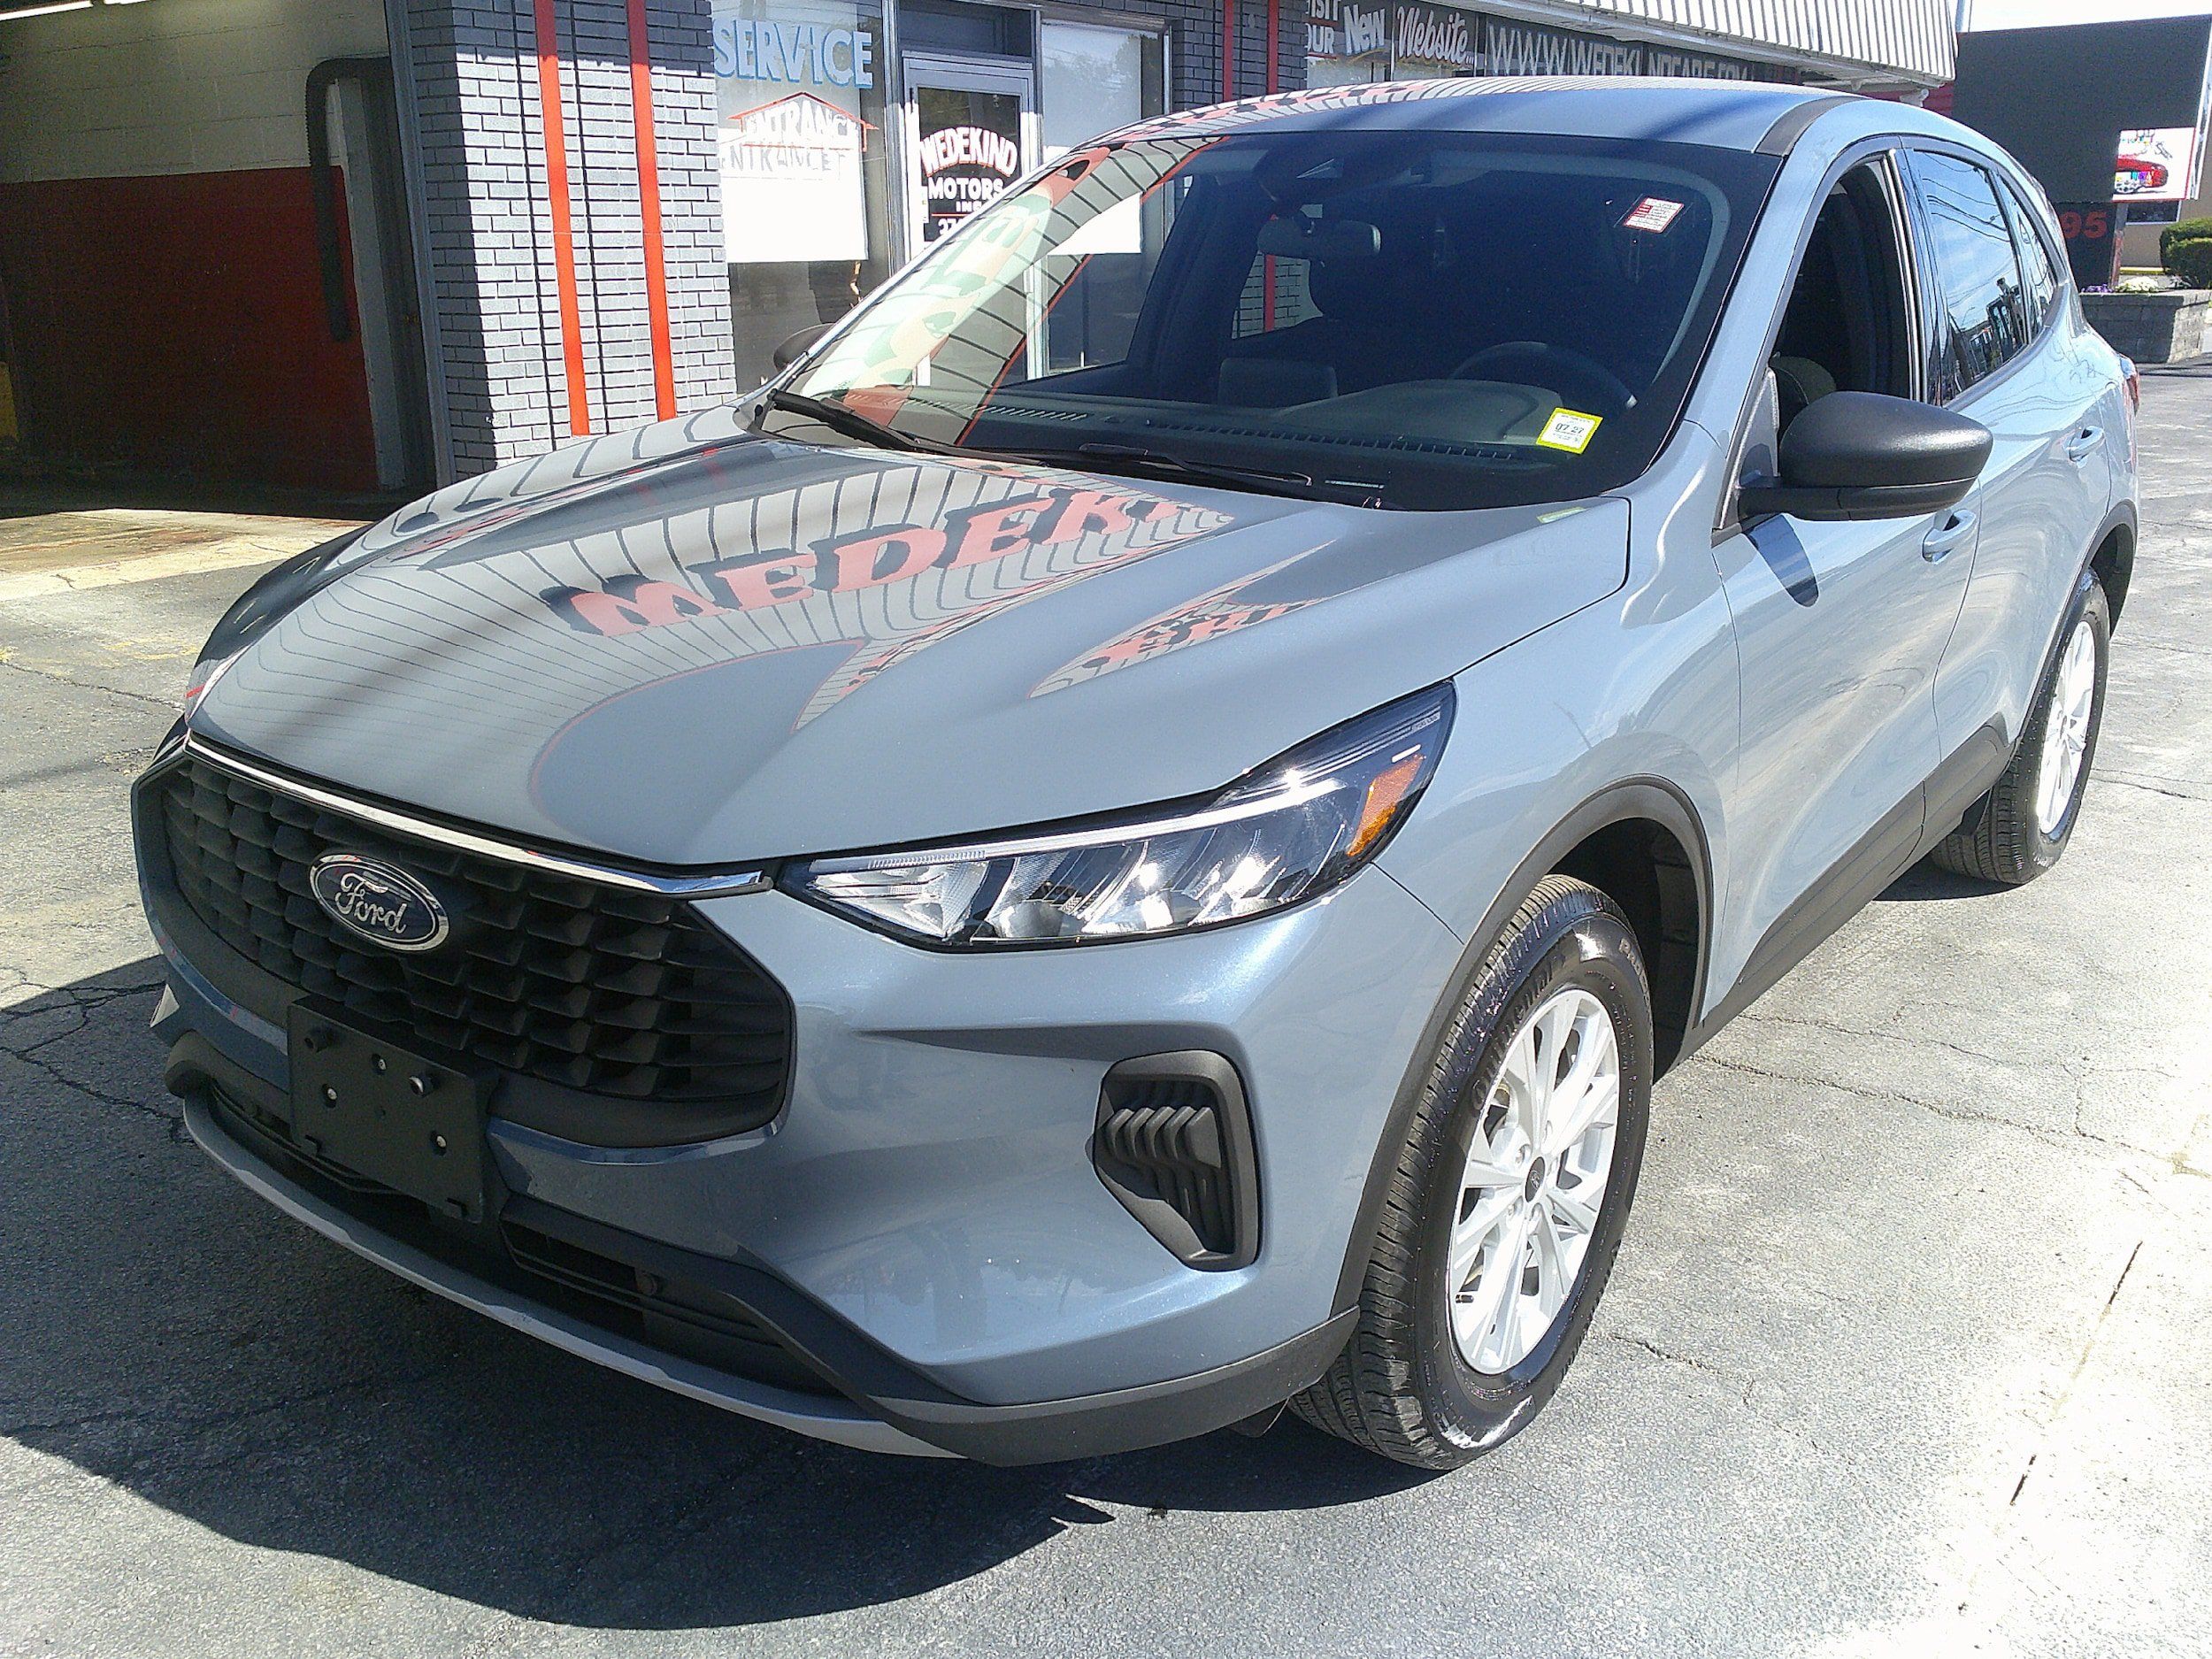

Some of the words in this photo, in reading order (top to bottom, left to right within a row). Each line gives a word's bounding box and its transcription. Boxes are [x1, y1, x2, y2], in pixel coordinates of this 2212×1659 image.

[1307, 0, 1340, 21] ISIT
[1343, 4, 1386, 56] New
[712, 18, 872, 88] SERVICE
[919, 126, 1018, 177] WEDEKIND
[927, 177, 1004, 200] MOTORS
[334, 872, 408, 934] Ford
